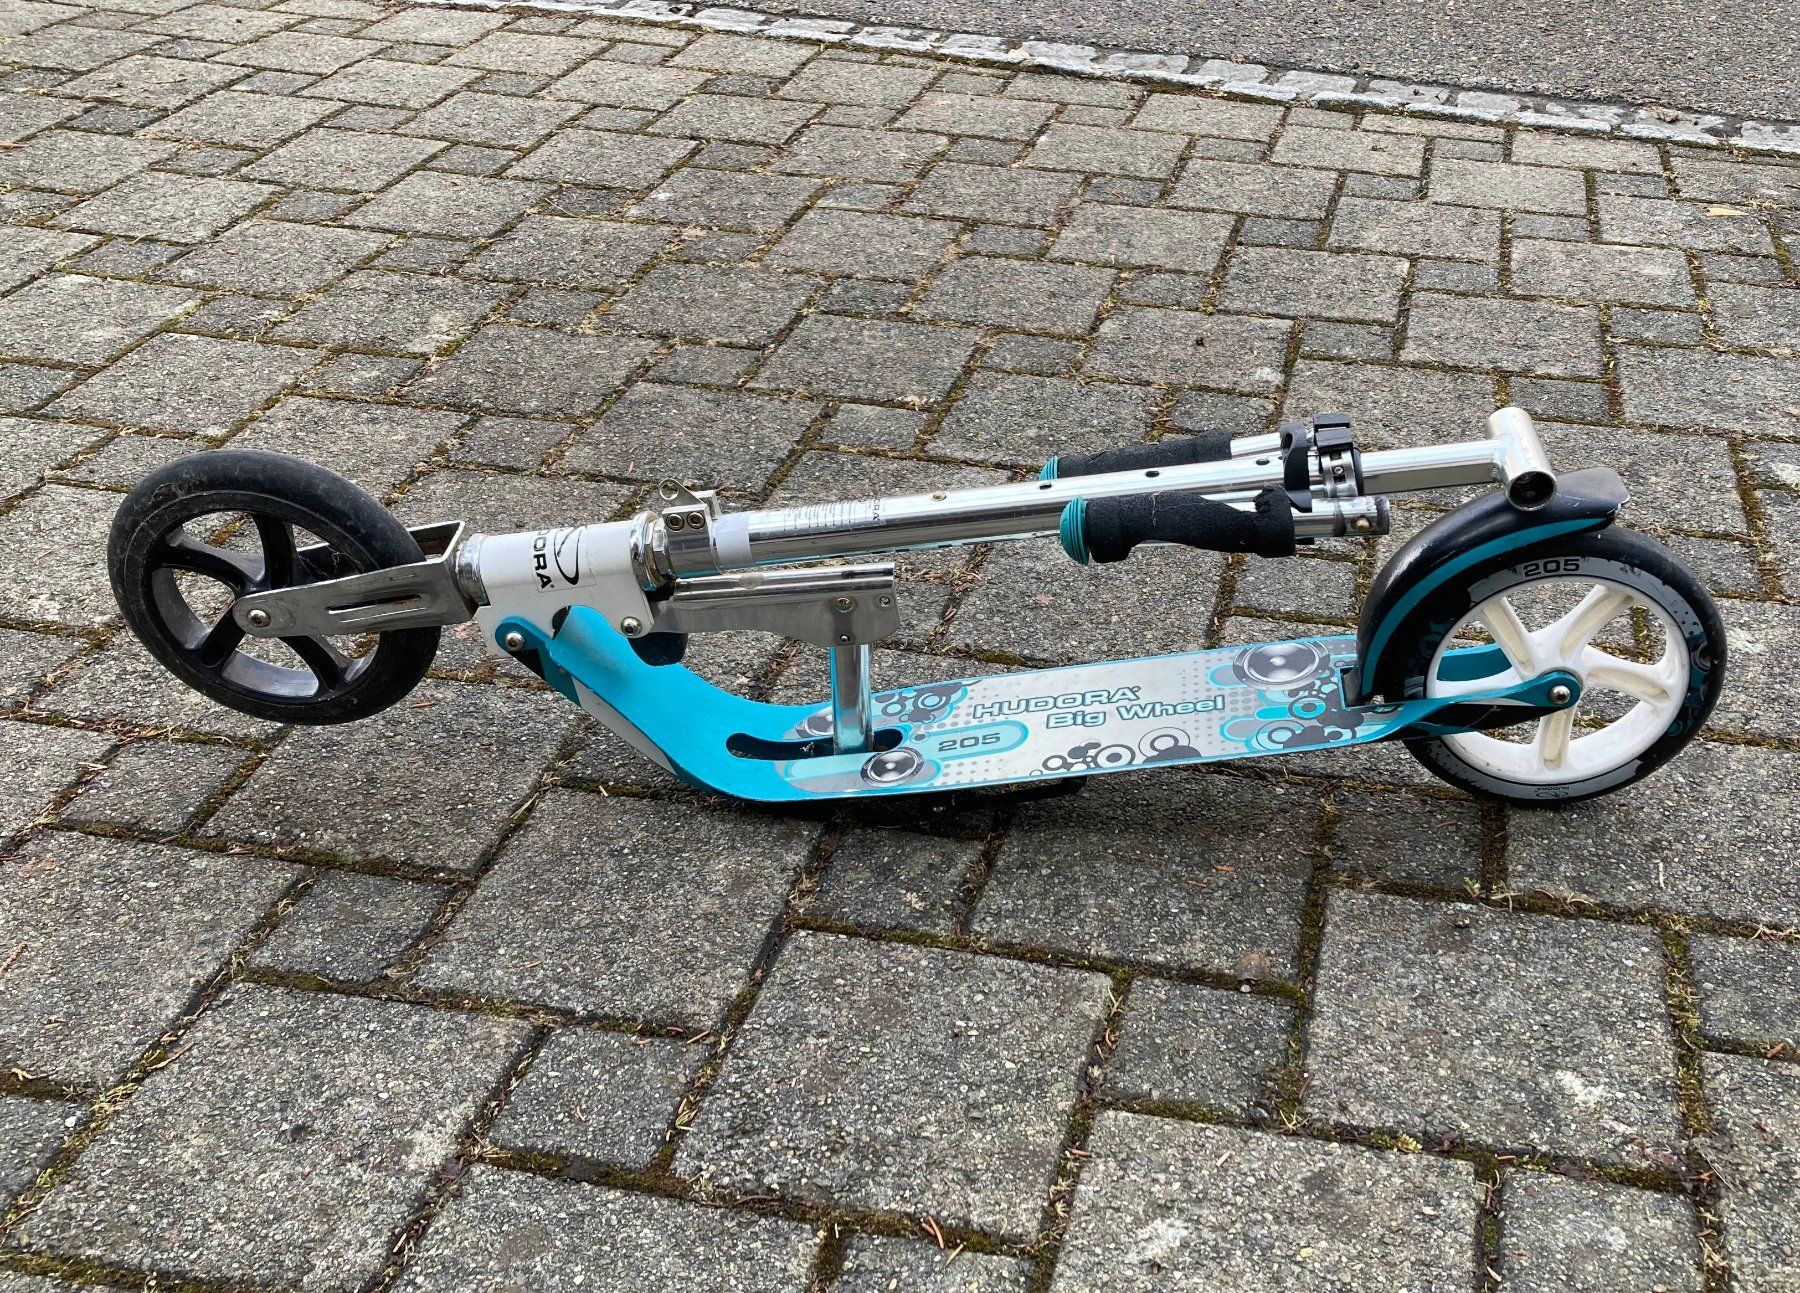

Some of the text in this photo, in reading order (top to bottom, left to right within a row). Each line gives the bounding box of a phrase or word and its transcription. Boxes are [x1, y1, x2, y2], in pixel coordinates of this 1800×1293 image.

[1523, 558, 1580, 578] 205
[1045, 694, 1226, 729] Big Wheel
[937, 732, 1001, 753] 205
